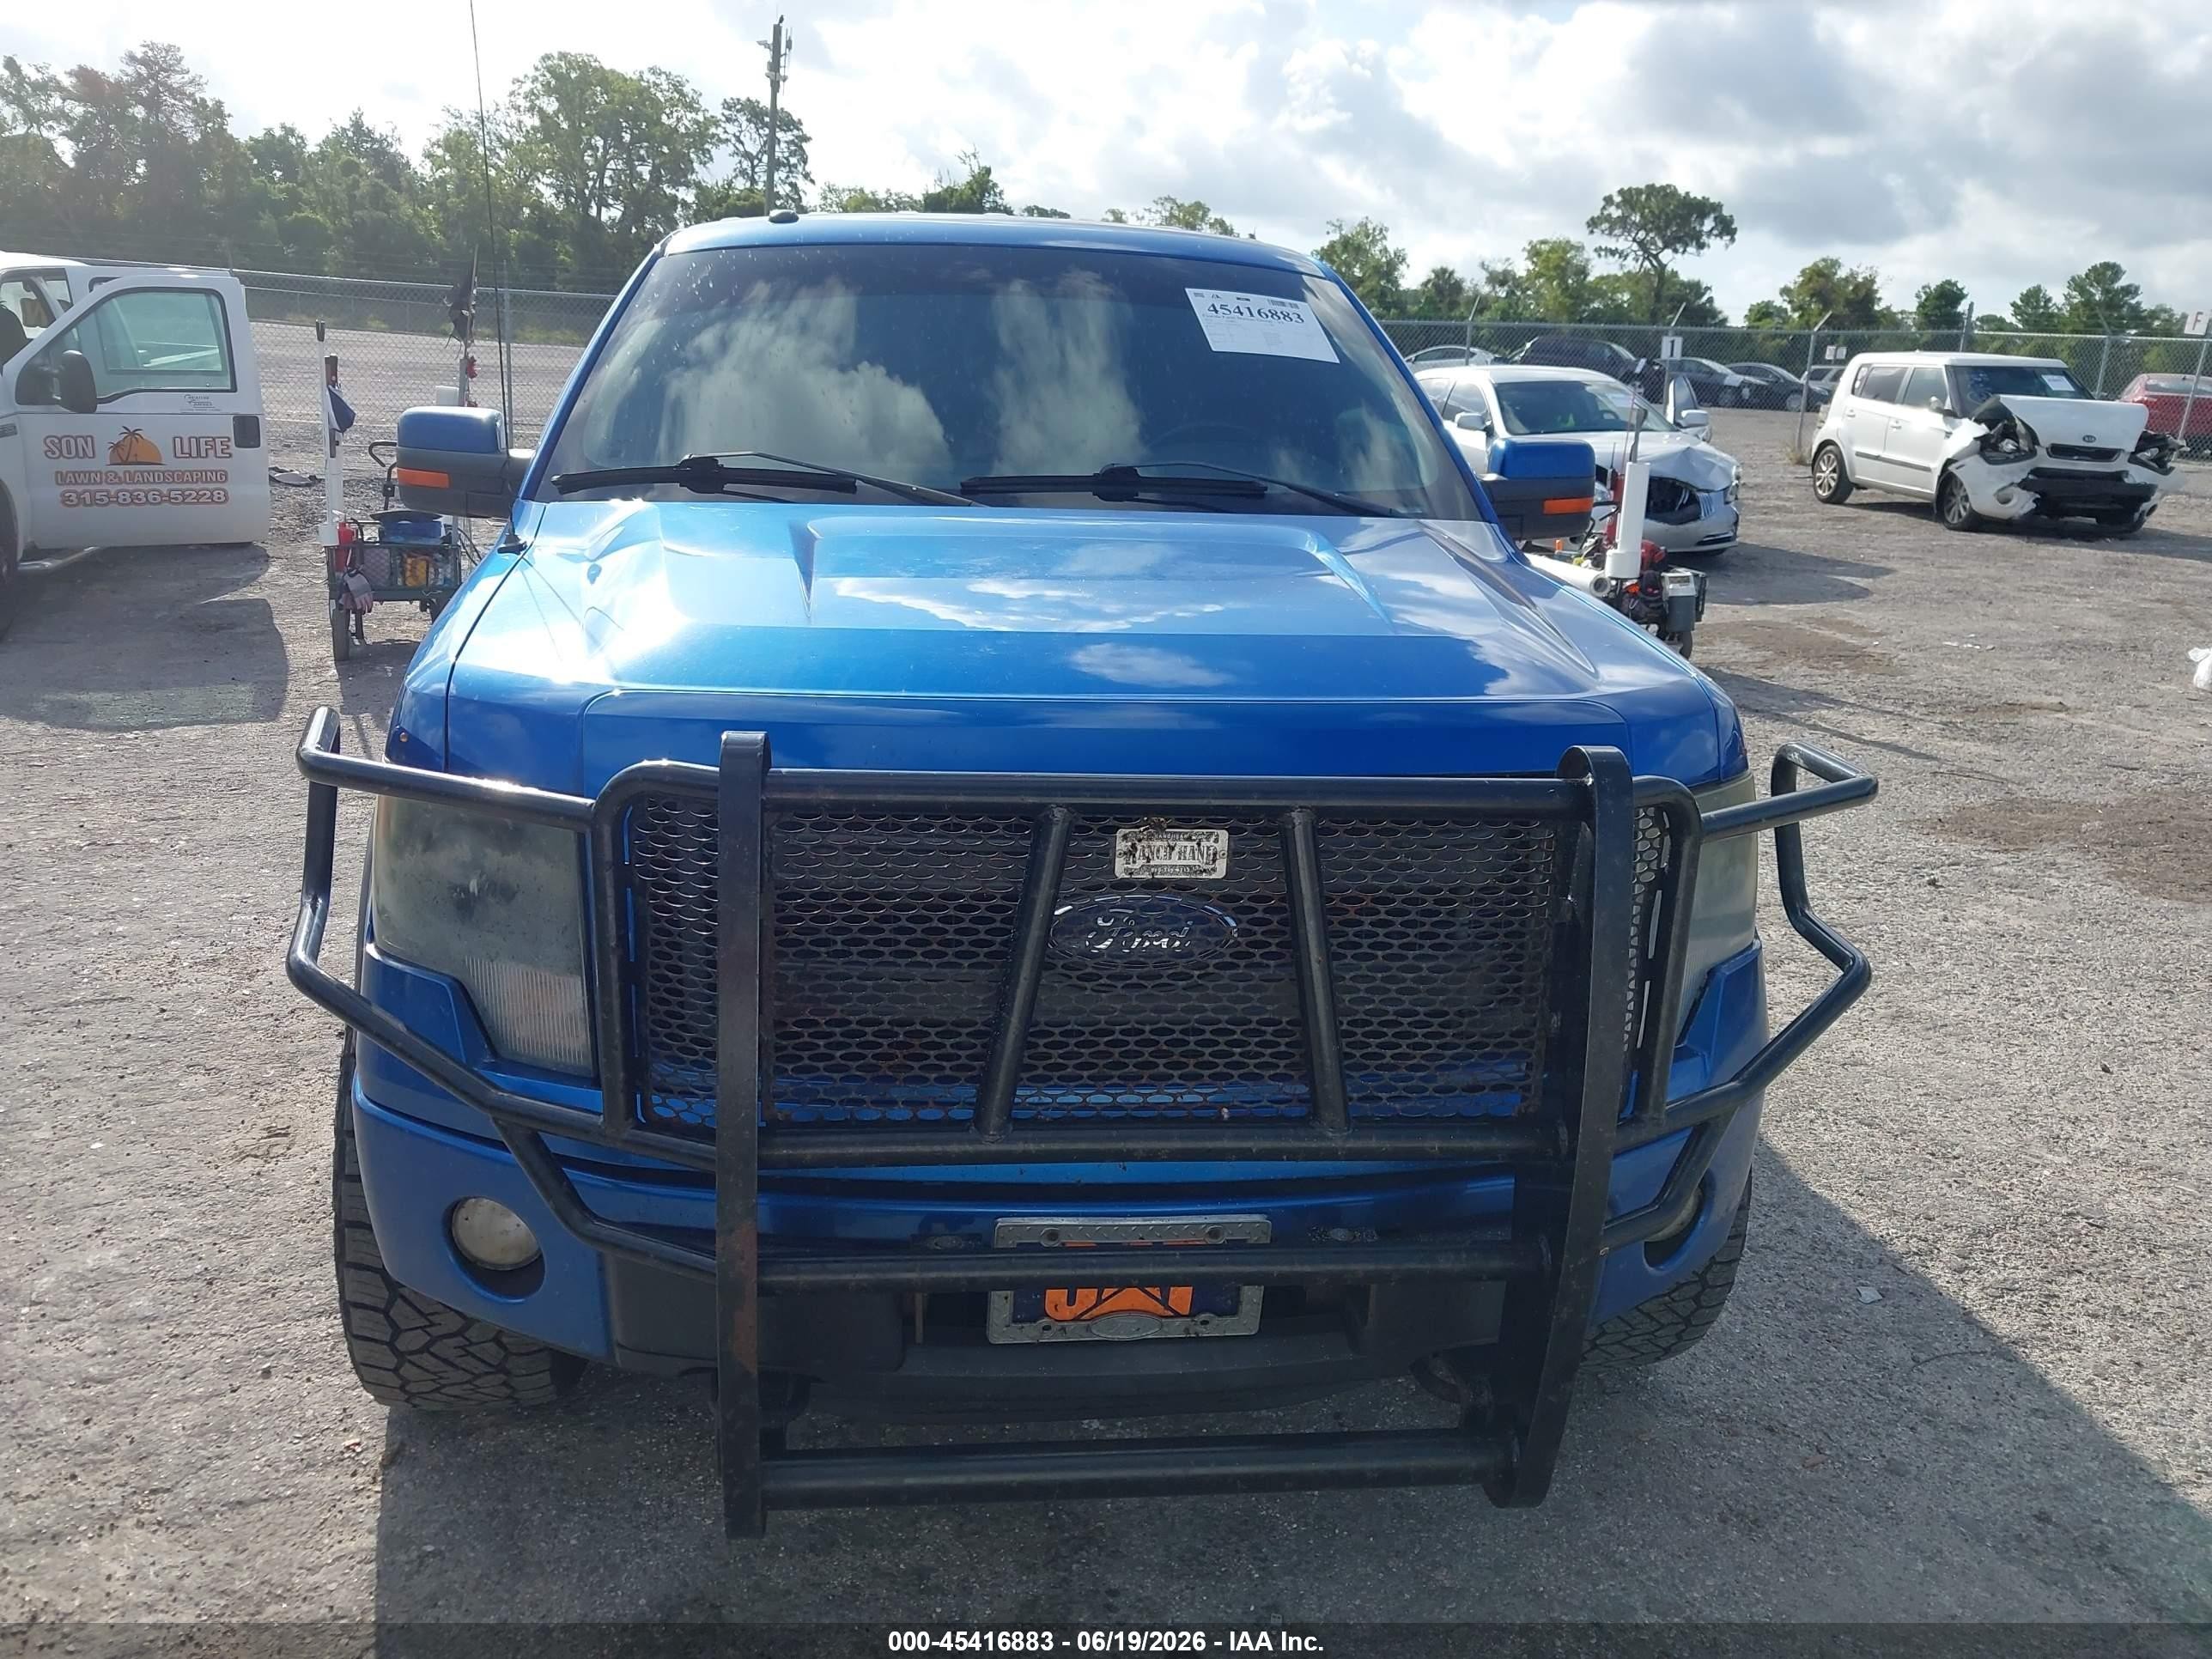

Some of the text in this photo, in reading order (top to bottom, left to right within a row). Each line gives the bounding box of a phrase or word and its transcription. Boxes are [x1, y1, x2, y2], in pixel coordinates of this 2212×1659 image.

[1207, 302, 1304, 324] 45416883
[2192, 311, 2203, 331] F
[45, 435, 232, 459] SON LIFE
[57, 471, 228, 485] LAWN & LANDSCAPING
[63, 489, 228, 507] 315-836-5228
